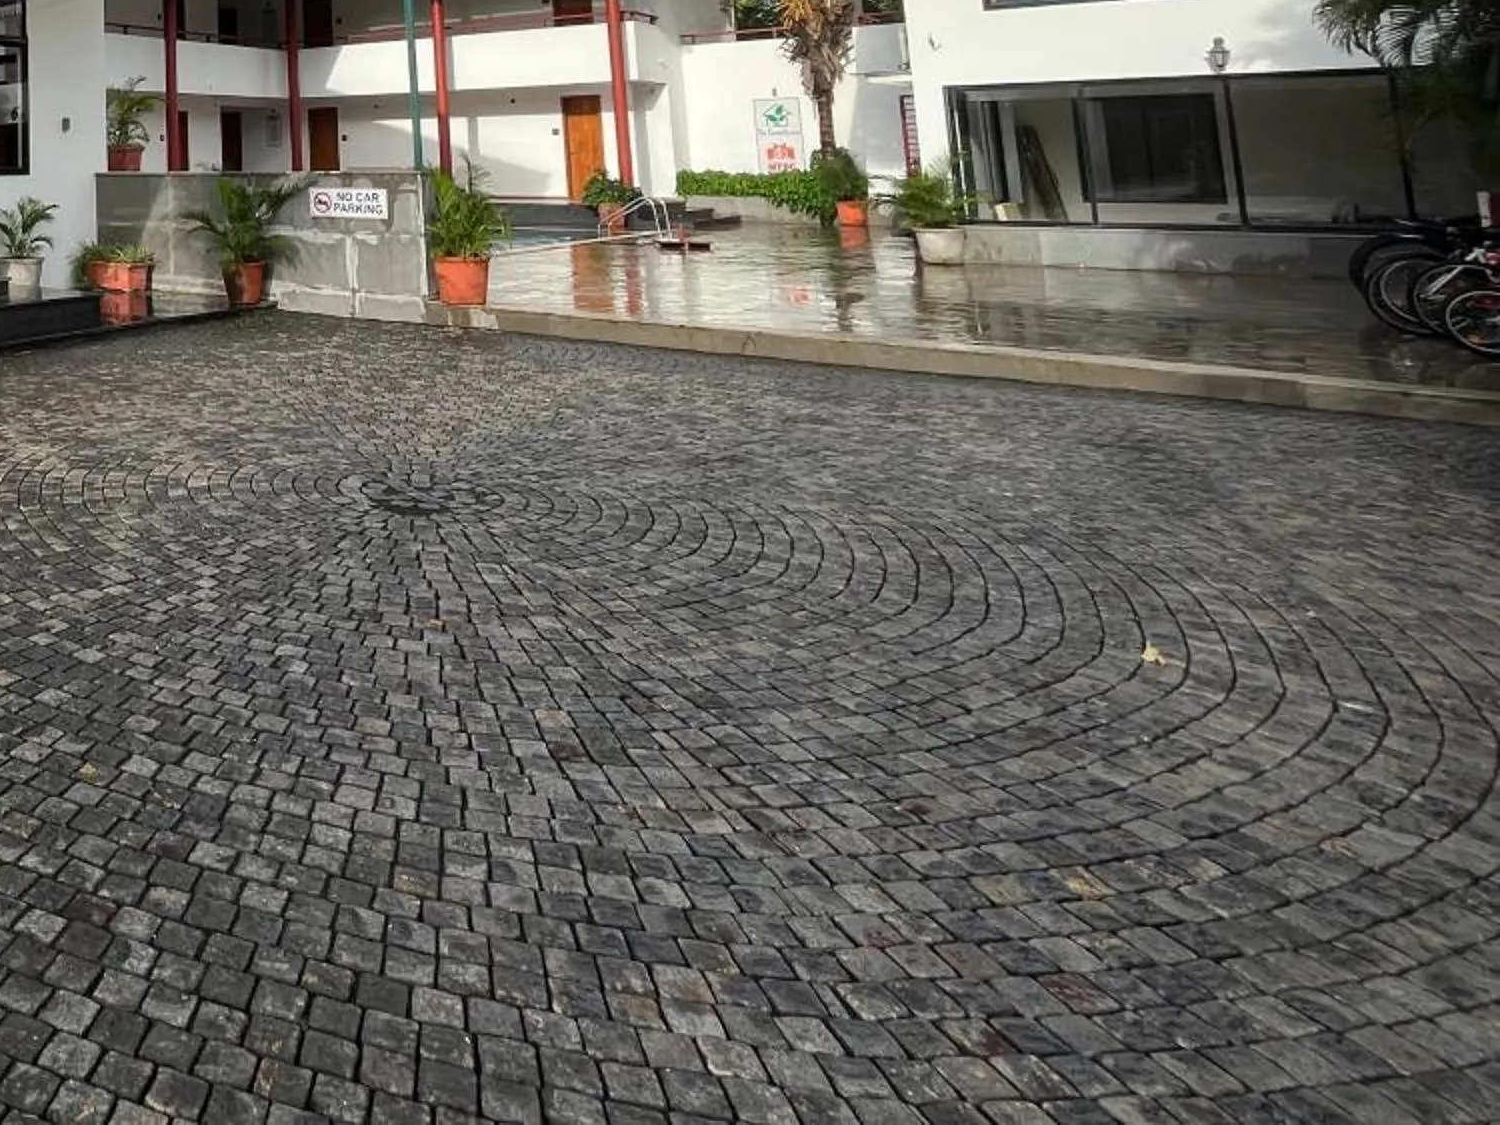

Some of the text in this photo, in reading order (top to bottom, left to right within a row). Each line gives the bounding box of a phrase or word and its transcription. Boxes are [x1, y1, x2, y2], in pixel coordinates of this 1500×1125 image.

[336, 192, 380, 203] NO CAR
[333, 203, 383, 215] PARKING
